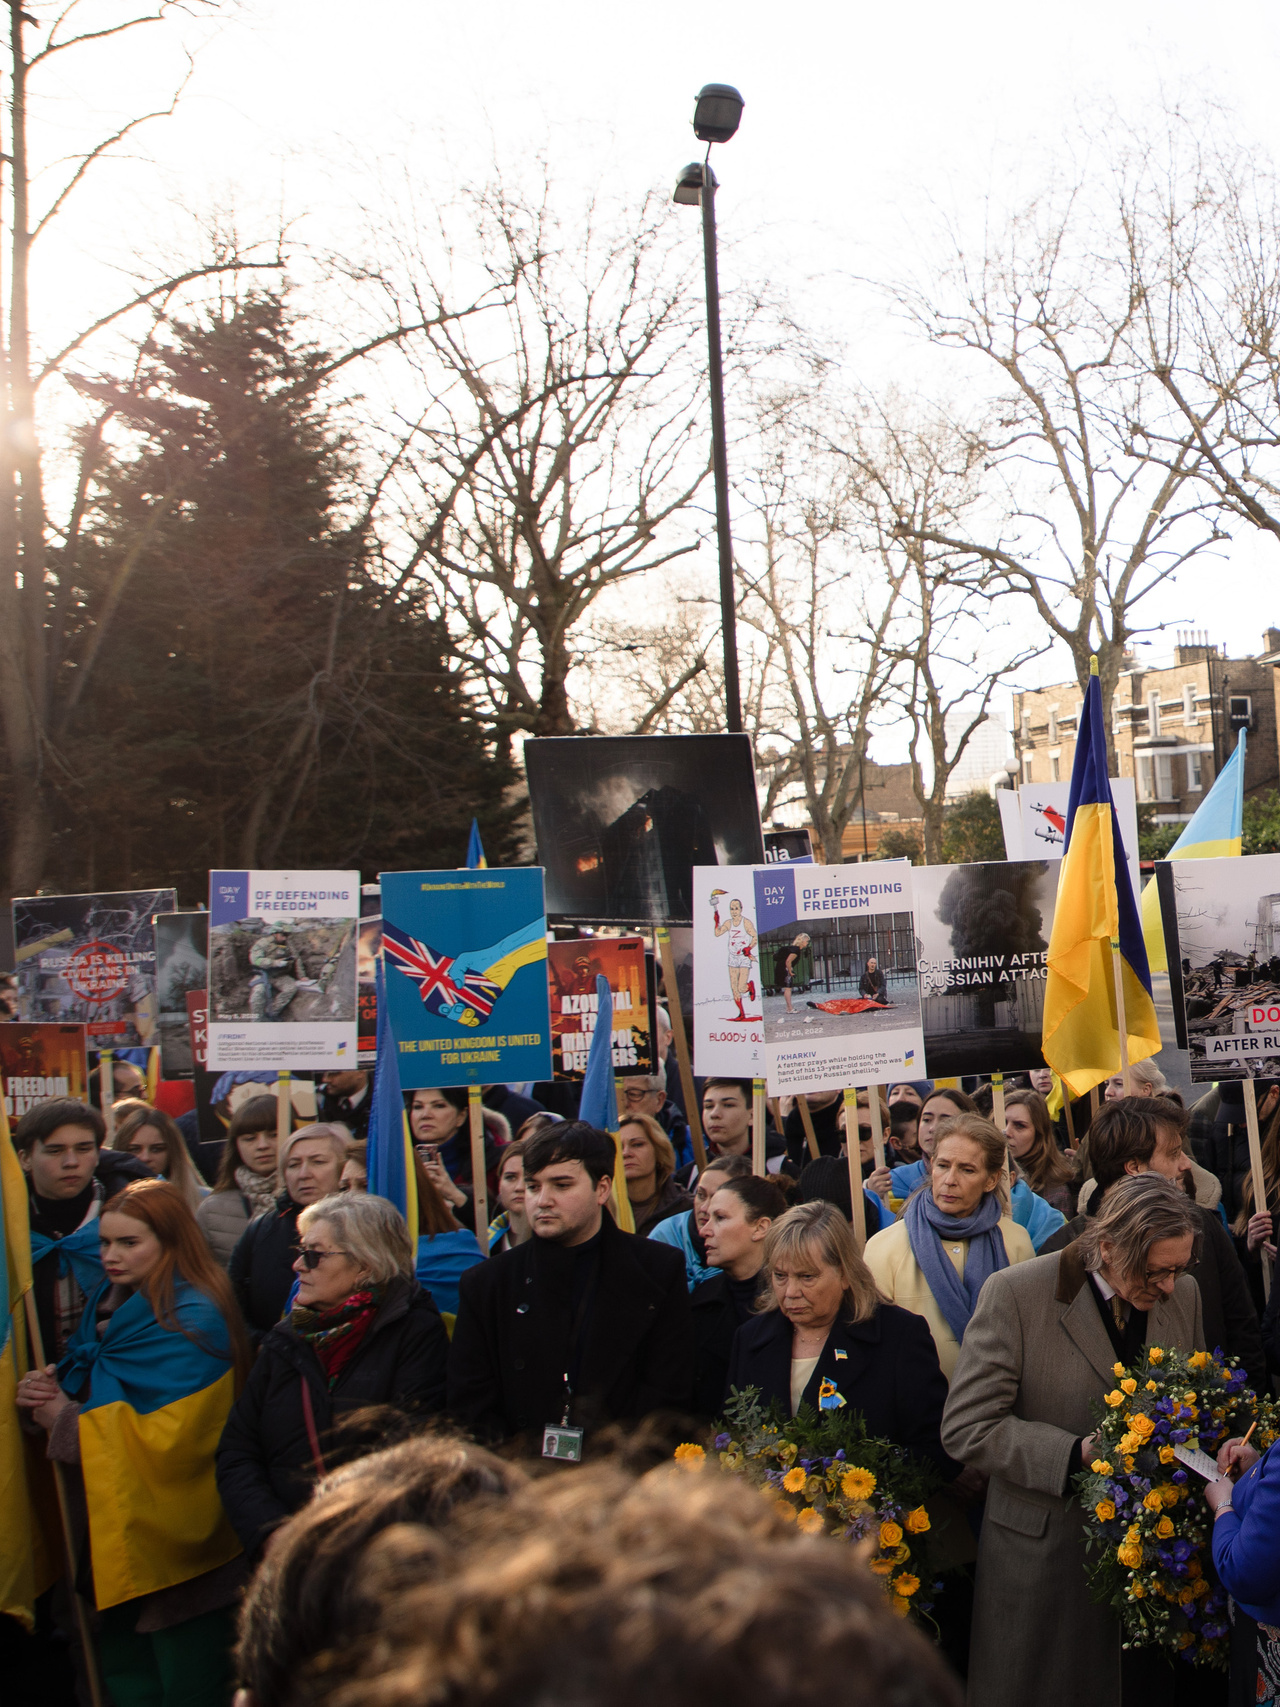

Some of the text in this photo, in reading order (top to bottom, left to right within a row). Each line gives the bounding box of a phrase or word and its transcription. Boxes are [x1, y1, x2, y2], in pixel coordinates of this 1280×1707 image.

[219, 886, 241, 894] DAY
[255, 891, 349, 900] OF DEFENDING
[764, 886, 785, 895] DAY
[803, 883, 902, 899] OF DEFENDING
[223, 895, 236, 903] 71
[766, 896, 785, 906] 147
[803, 897, 870, 911] FREEDOM
[255, 902, 317, 911] FREEDOM
[40, 951, 157, 969] RUSSIA IS KILLING
[917, 951, 1048, 974] CHERNIHIV AFTE
[59, 966, 123, 979] CIVILIANS
[923, 967, 1048, 988] RUSSIAN ATTAC
[72, 978, 129, 991] UKRAINE
[709, 1032, 747, 1043] BLOODY
[774, 1031, 790, 1039] July
[804, 1027, 824, 1035] 2022
[398, 1034, 541, 1053] THE UNITED KINGDOM IS UNITED
[1213, 1036, 1259, 1053] AFTER
[441, 1050, 501, 1065] FOR UKRAINE
[776, 1051, 817, 1061] /KHARKIV
[783, 1060, 806, 1069] father
[807, 1058, 827, 1067] prays
[828, 1055, 847, 1063] while
[848, 1053, 873, 1062] holding
[777, 1068, 795, 1076] hand
[777, 1076, 791, 1085] just
[793, 1074, 813, 1082] killed
[823, 1070, 850, 1078] Russian
[7, 1076, 68, 1096] FREEDOM
